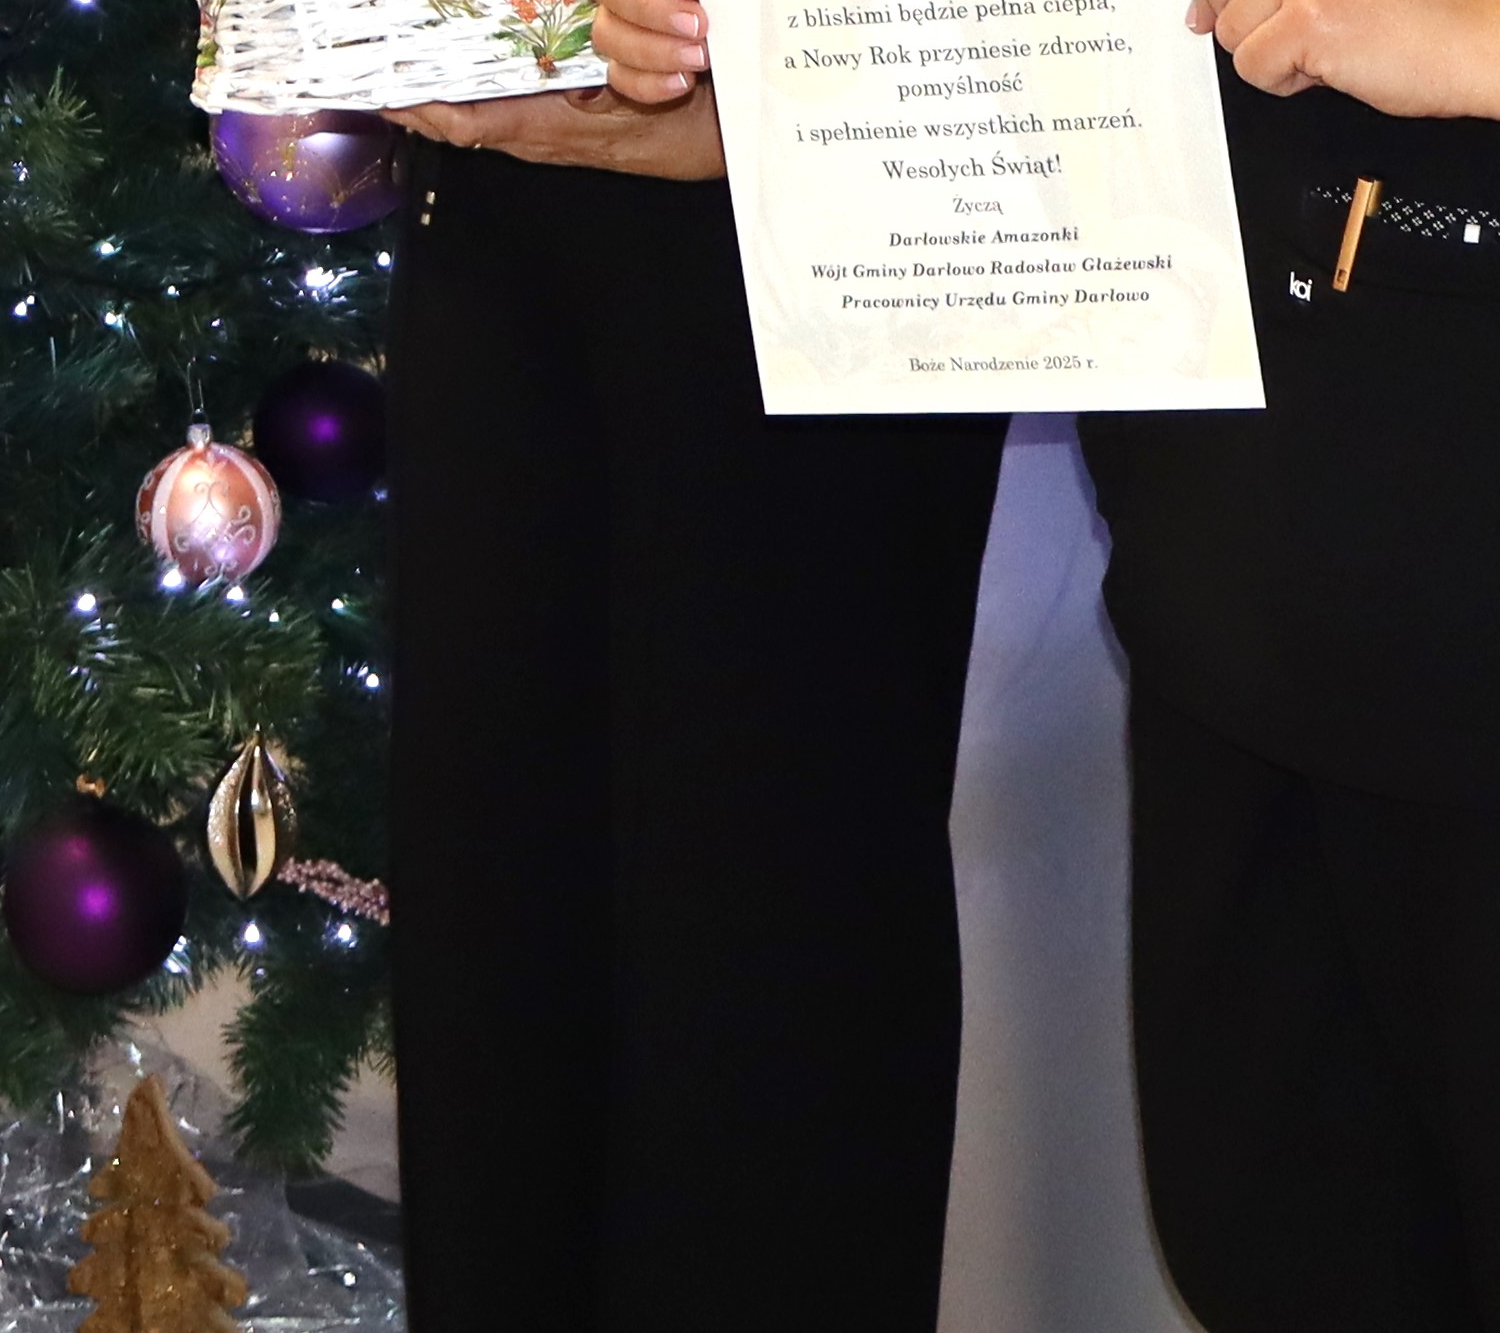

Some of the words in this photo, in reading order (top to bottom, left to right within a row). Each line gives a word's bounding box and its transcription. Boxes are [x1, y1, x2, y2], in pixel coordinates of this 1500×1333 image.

[787, 15, 800, 29] z
[802, 4, 893, 28] bliskimi
[896, 0, 969, 27] będzie
[783, 55, 798, 70] a
[801, 48, 863, 71] Nowy
[868, 43, 913, 66] Rok
[918, 37, 1032, 68] przyniesie
[1038, 31, 1133, 57] zdrowie,
[896, 71, 1024, 103] pomyślność
[795, 123, 805, 143] i
[809, 119, 918, 147] spełnienie
[923, 112, 1046, 141] wszystkich
[1051, 107, 1143, 132] marzeń.
[881, 156, 986, 183] Wesołych
[990, 149, 1063, 179] Świąt!
[952, 194, 1005, 216] Życzą
[888, 229, 987, 248] Darłowskie
[990, 225, 1079, 244] Amazonki
[852, 263, 908, 281] Gminy
[912, 261, 986, 278] Darłowo
[989, 258, 1077, 276] Radosław
[841, 293, 940, 312] Pracownicy
[945, 291, 1007, 311] Urzędu
[1011, 289, 1070, 308] Gminy
[1073, 287, 1150, 304] Darłowo
[1289, 270, 1313, 302] koi
[908, 357, 946, 372] Boże
[949, 356, 1040, 372] Narodzenie
[1042, 355, 1082, 370] 2025
